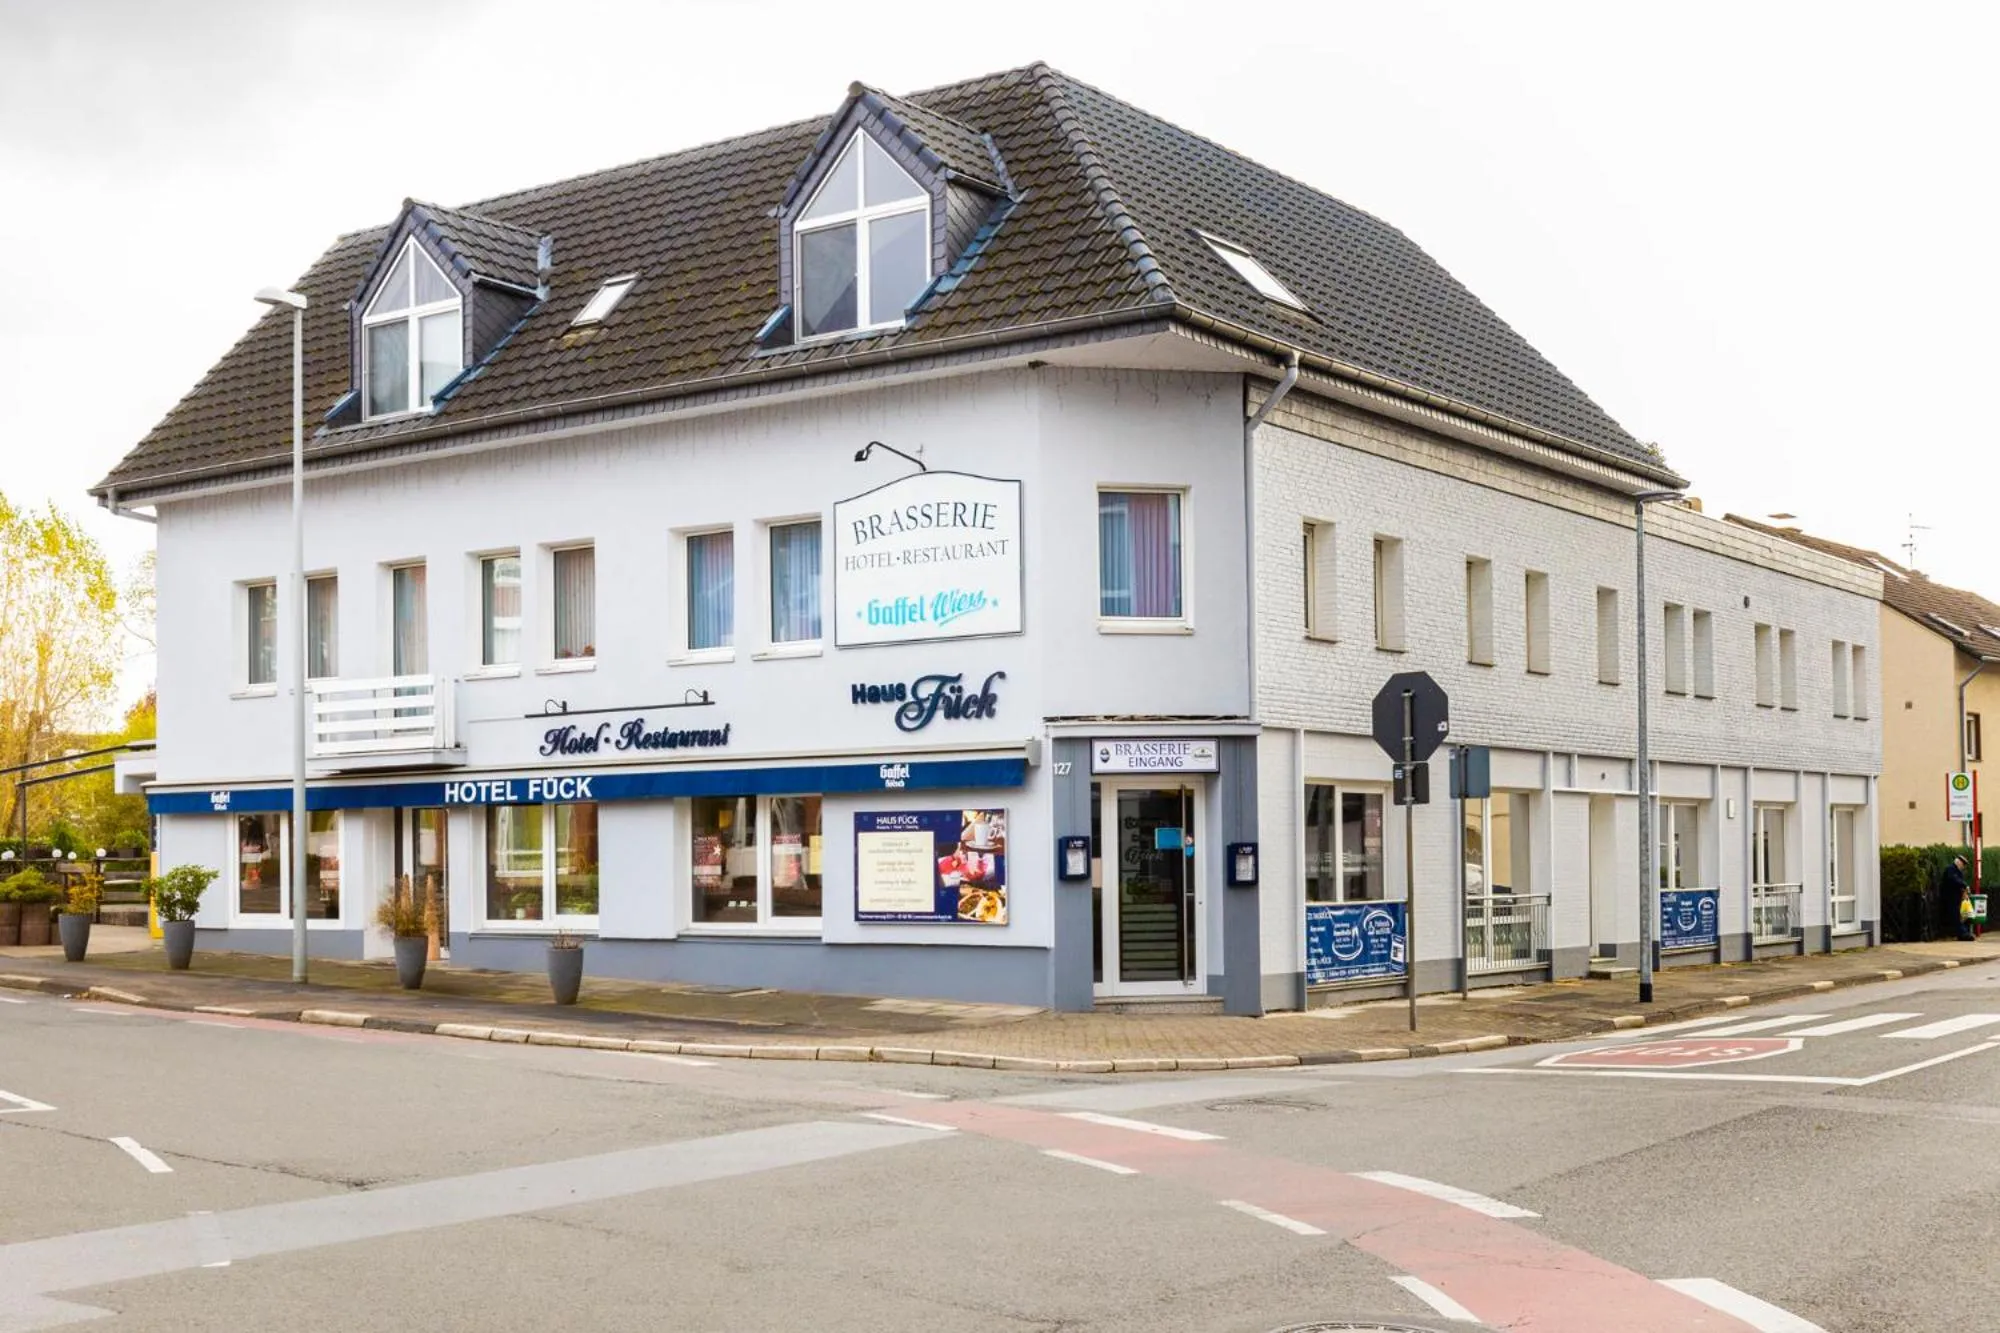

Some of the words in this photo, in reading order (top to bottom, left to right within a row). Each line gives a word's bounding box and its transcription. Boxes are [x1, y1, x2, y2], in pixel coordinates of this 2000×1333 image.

[852, 502, 998, 545] BRASSERIE
[868, 594, 926, 627] Gaffel
[852, 682, 906, 704] Haus
[895, 671, 1006, 732] Fück
[539, 722, 610, 756] Hotel
[616, 717, 731, 751] Restaurant
[1115, 743, 1192, 756] BRASSERIE
[879, 763, 911, 779] Gaffel
[1054, 762, 1072, 776] 127
[1128, 756, 1184, 768] EINGANG
[445, 780, 518, 803] HOTEL
[528, 776, 593, 800] FÜCK
[876, 815, 897, 824] HAUS
[897, 814, 918, 824] FÜCK
